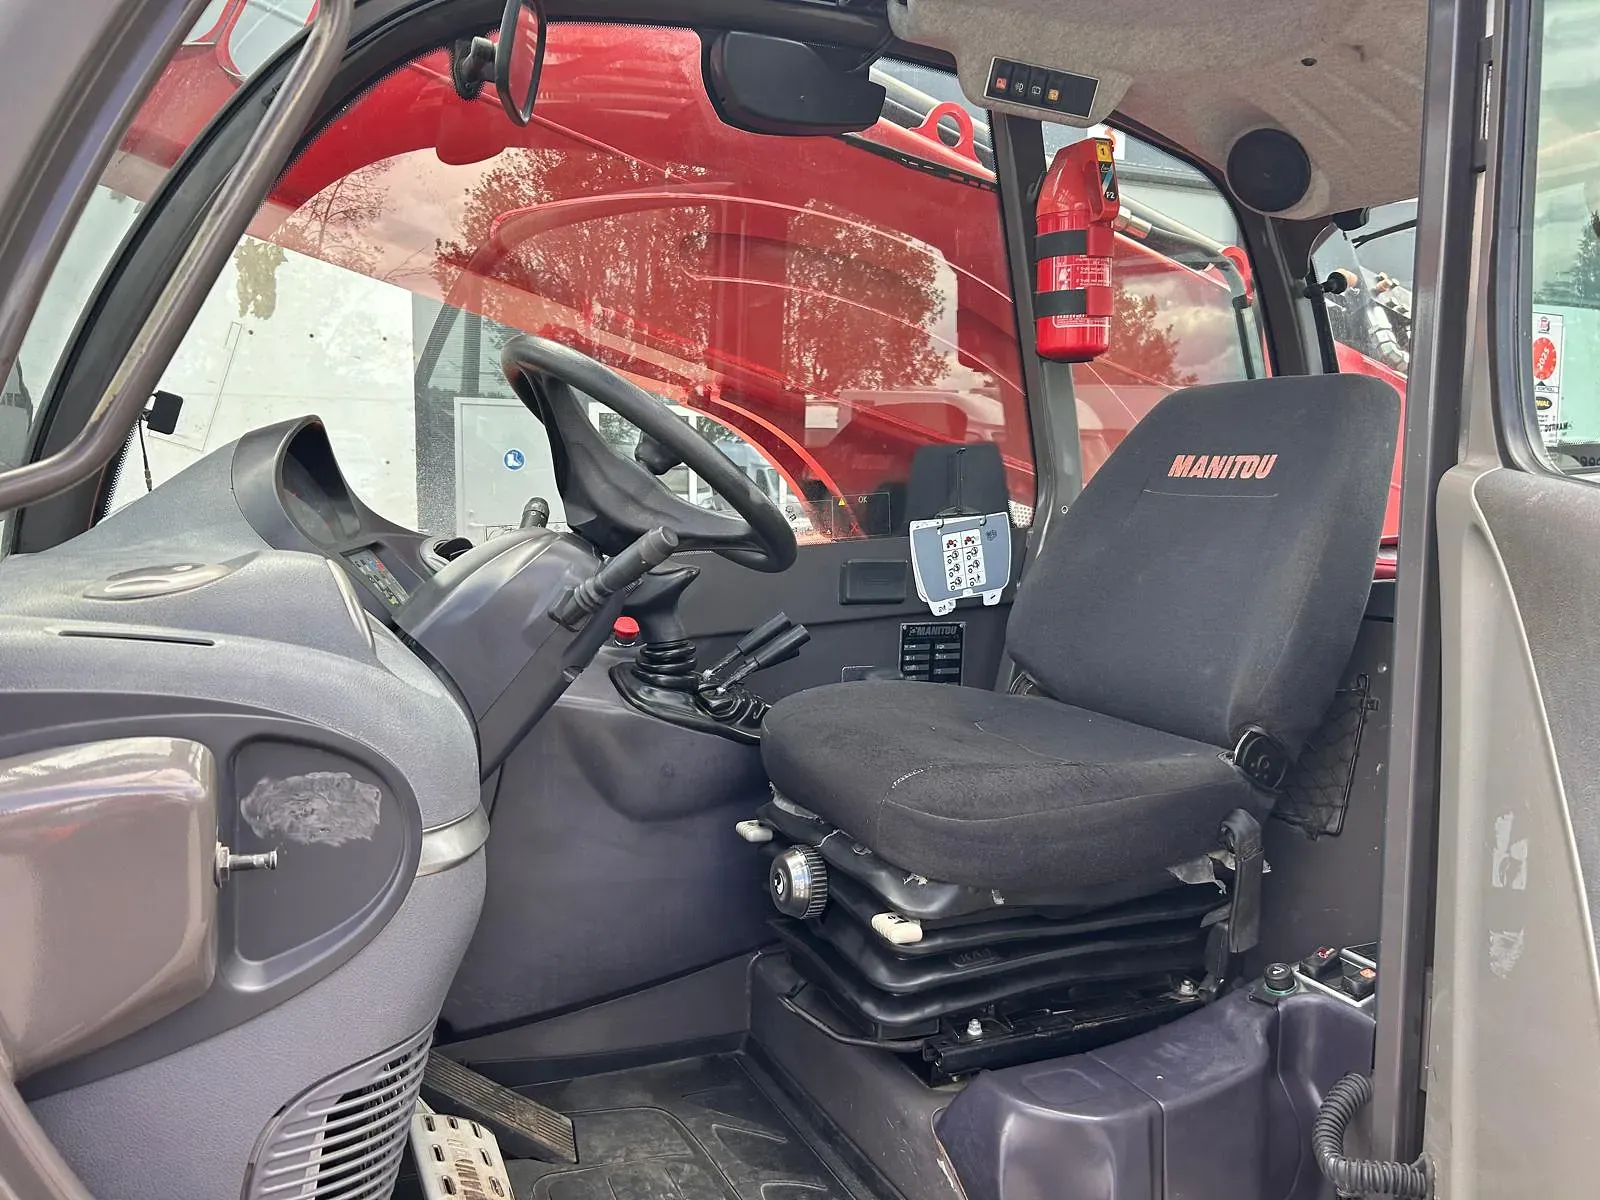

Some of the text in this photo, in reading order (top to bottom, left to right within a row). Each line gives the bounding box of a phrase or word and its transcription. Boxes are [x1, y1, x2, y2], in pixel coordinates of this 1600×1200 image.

[1536, 346, 1550, 371] 2025
[1167, 454, 1279, 480] MANITOU
[858, 495, 868, 504] OK
[916, 625, 957, 636] MANITOU
